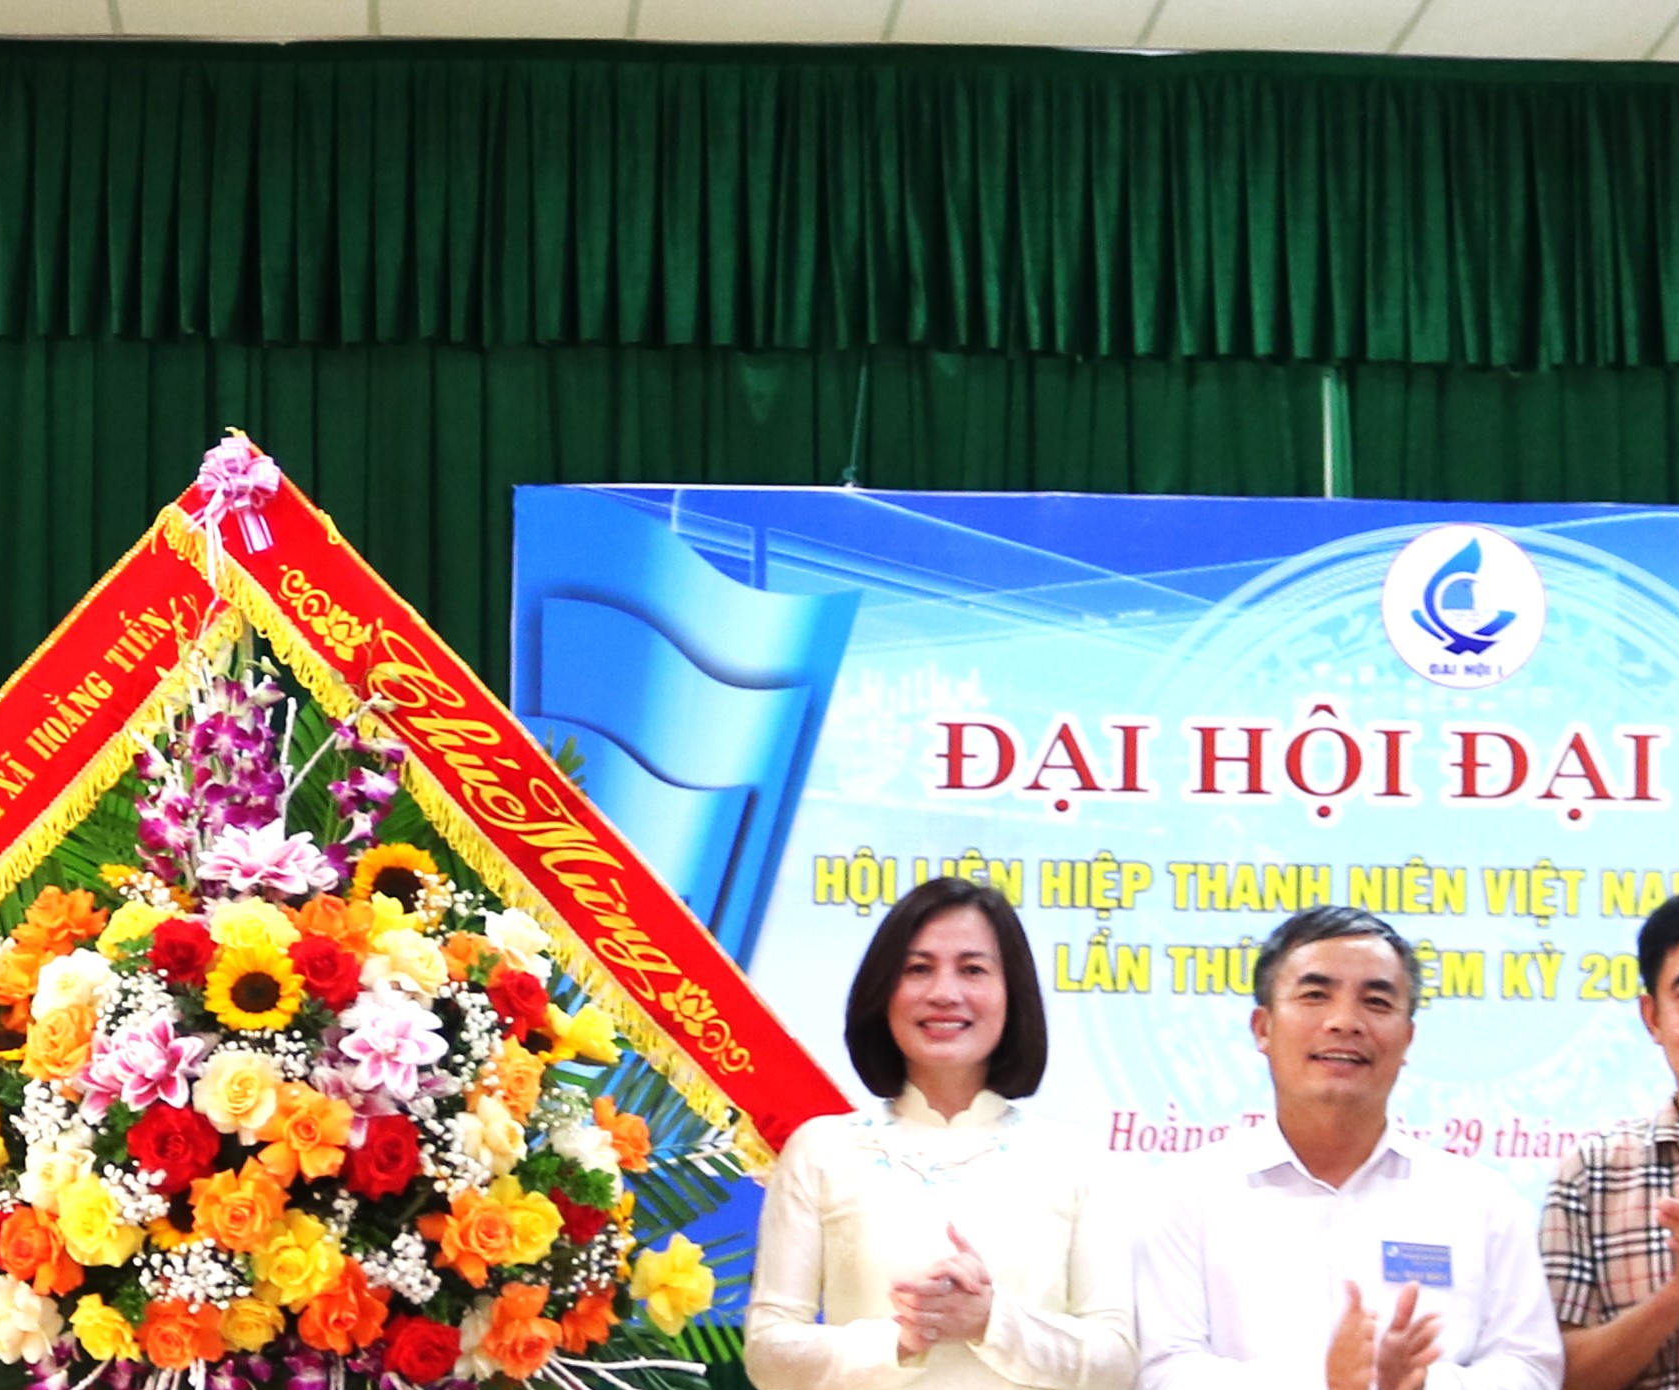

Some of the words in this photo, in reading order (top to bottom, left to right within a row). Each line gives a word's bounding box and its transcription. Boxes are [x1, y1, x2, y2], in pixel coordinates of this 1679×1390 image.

[25, 671, 114, 760] HOẰNG
[103, 606, 172, 673] TIẾN
[367, 629, 528, 818] Chúc
[469, 776, 681, 1002] Mừng
[935, 721, 1151, 813] ĐẠI
[1191, 704, 1413, 819] HỘI
[1450, 730, 1661, 821] ĐẠI
[814, 846, 898, 917] HỘI
[1040, 850, 1152, 919] HIỆP
[1168, 860, 1331, 913] THANH
[1349, 856, 1467, 915] NIÊN
[1482, 858, 1585, 927] VIỆT
[1055, 927, 1152, 995] LẦN
[1502, 941, 1565, 1000] KỲ
